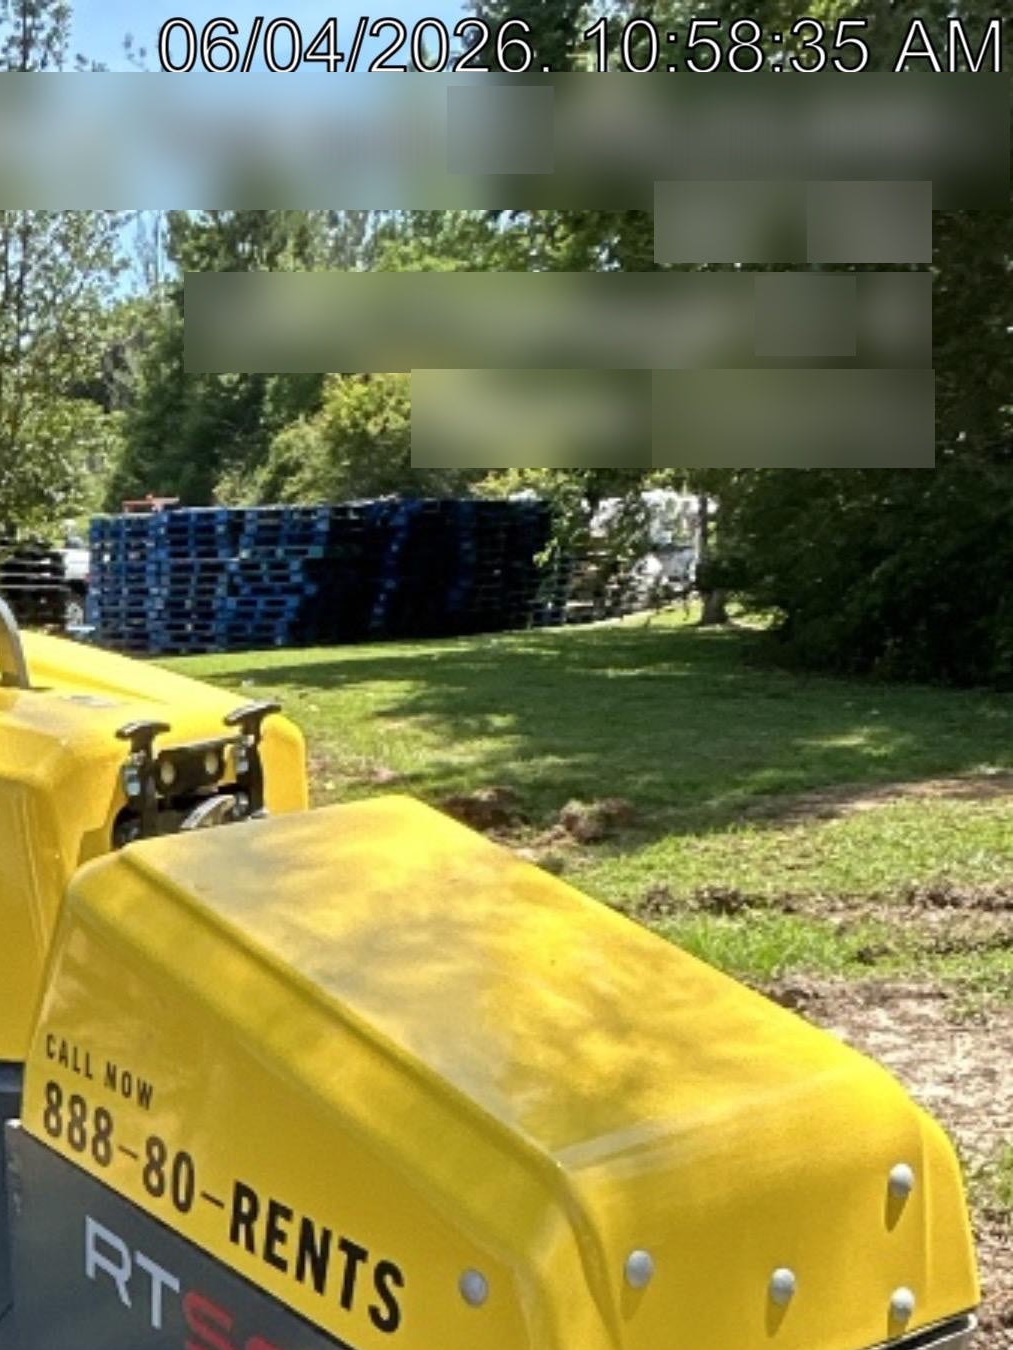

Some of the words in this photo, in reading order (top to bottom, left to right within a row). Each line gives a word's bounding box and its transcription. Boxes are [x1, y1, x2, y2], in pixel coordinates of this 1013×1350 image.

[45, 1033, 94, 1081] CALL
[105, 1059, 155, 1111] NOW
[41, 1082, 407, 1335] 888-80-RENTS
